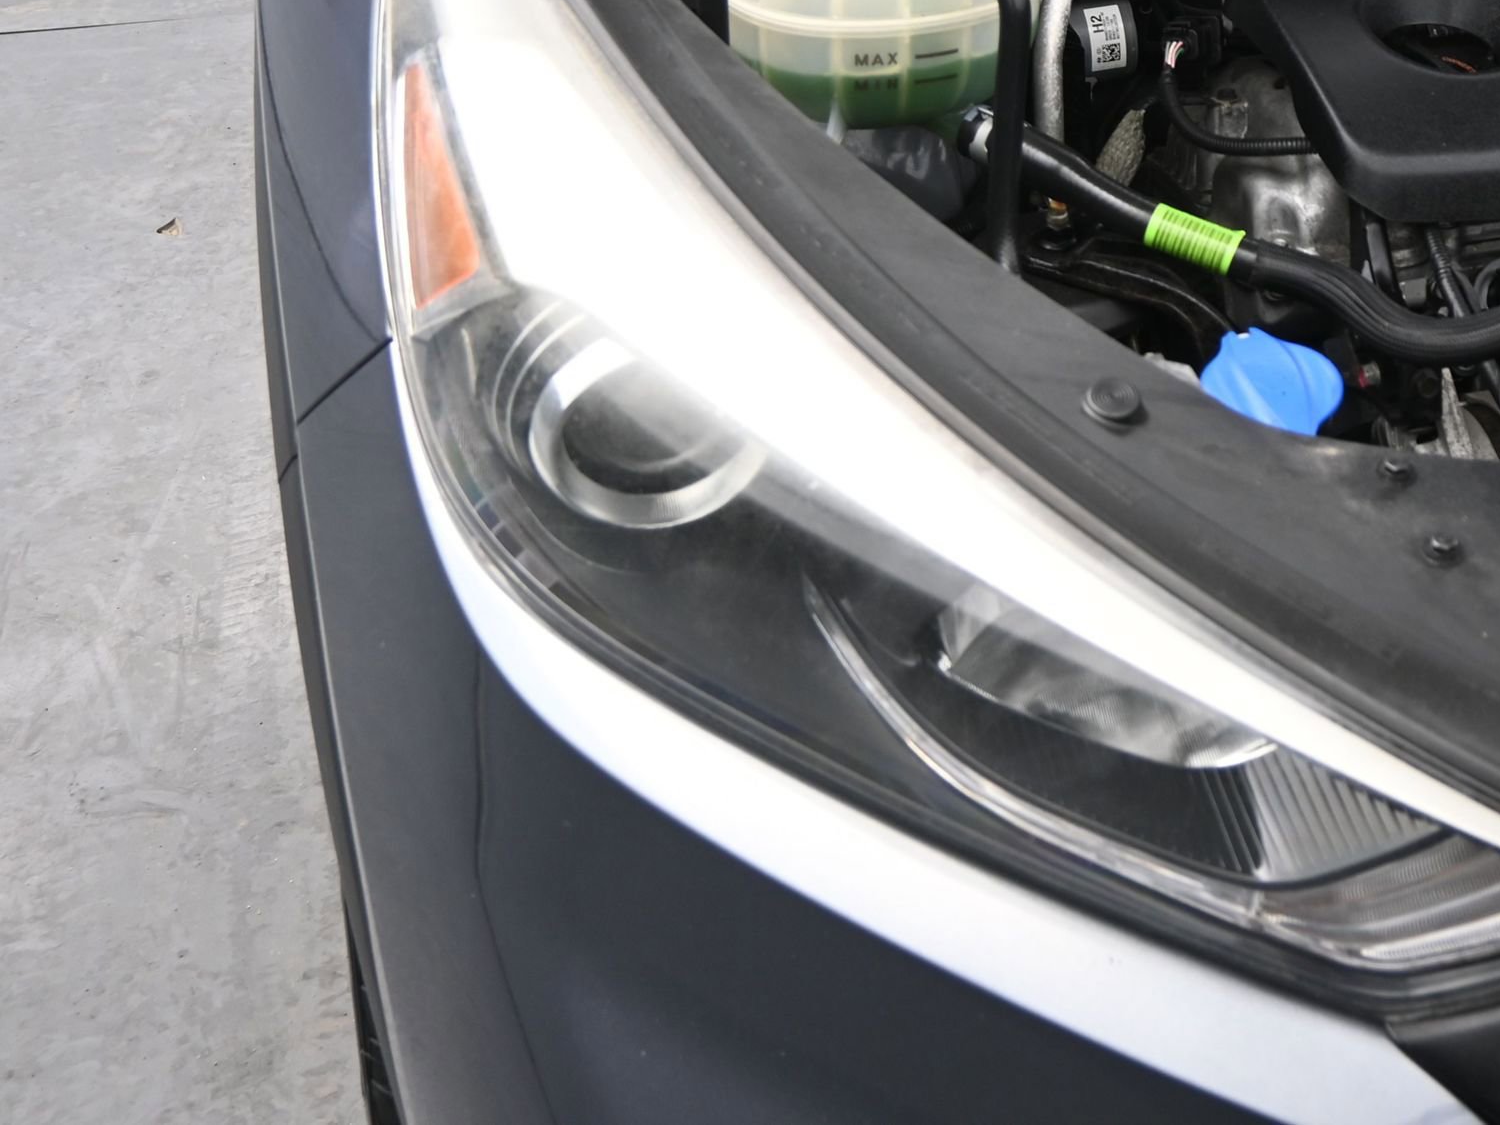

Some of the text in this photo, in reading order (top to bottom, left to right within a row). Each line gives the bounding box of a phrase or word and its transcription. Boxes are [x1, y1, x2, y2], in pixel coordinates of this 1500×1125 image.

[1090, 15, 1105, 34] H2
[854, 52, 898, 66] MAX
[854, 77, 898, 91] MIN
